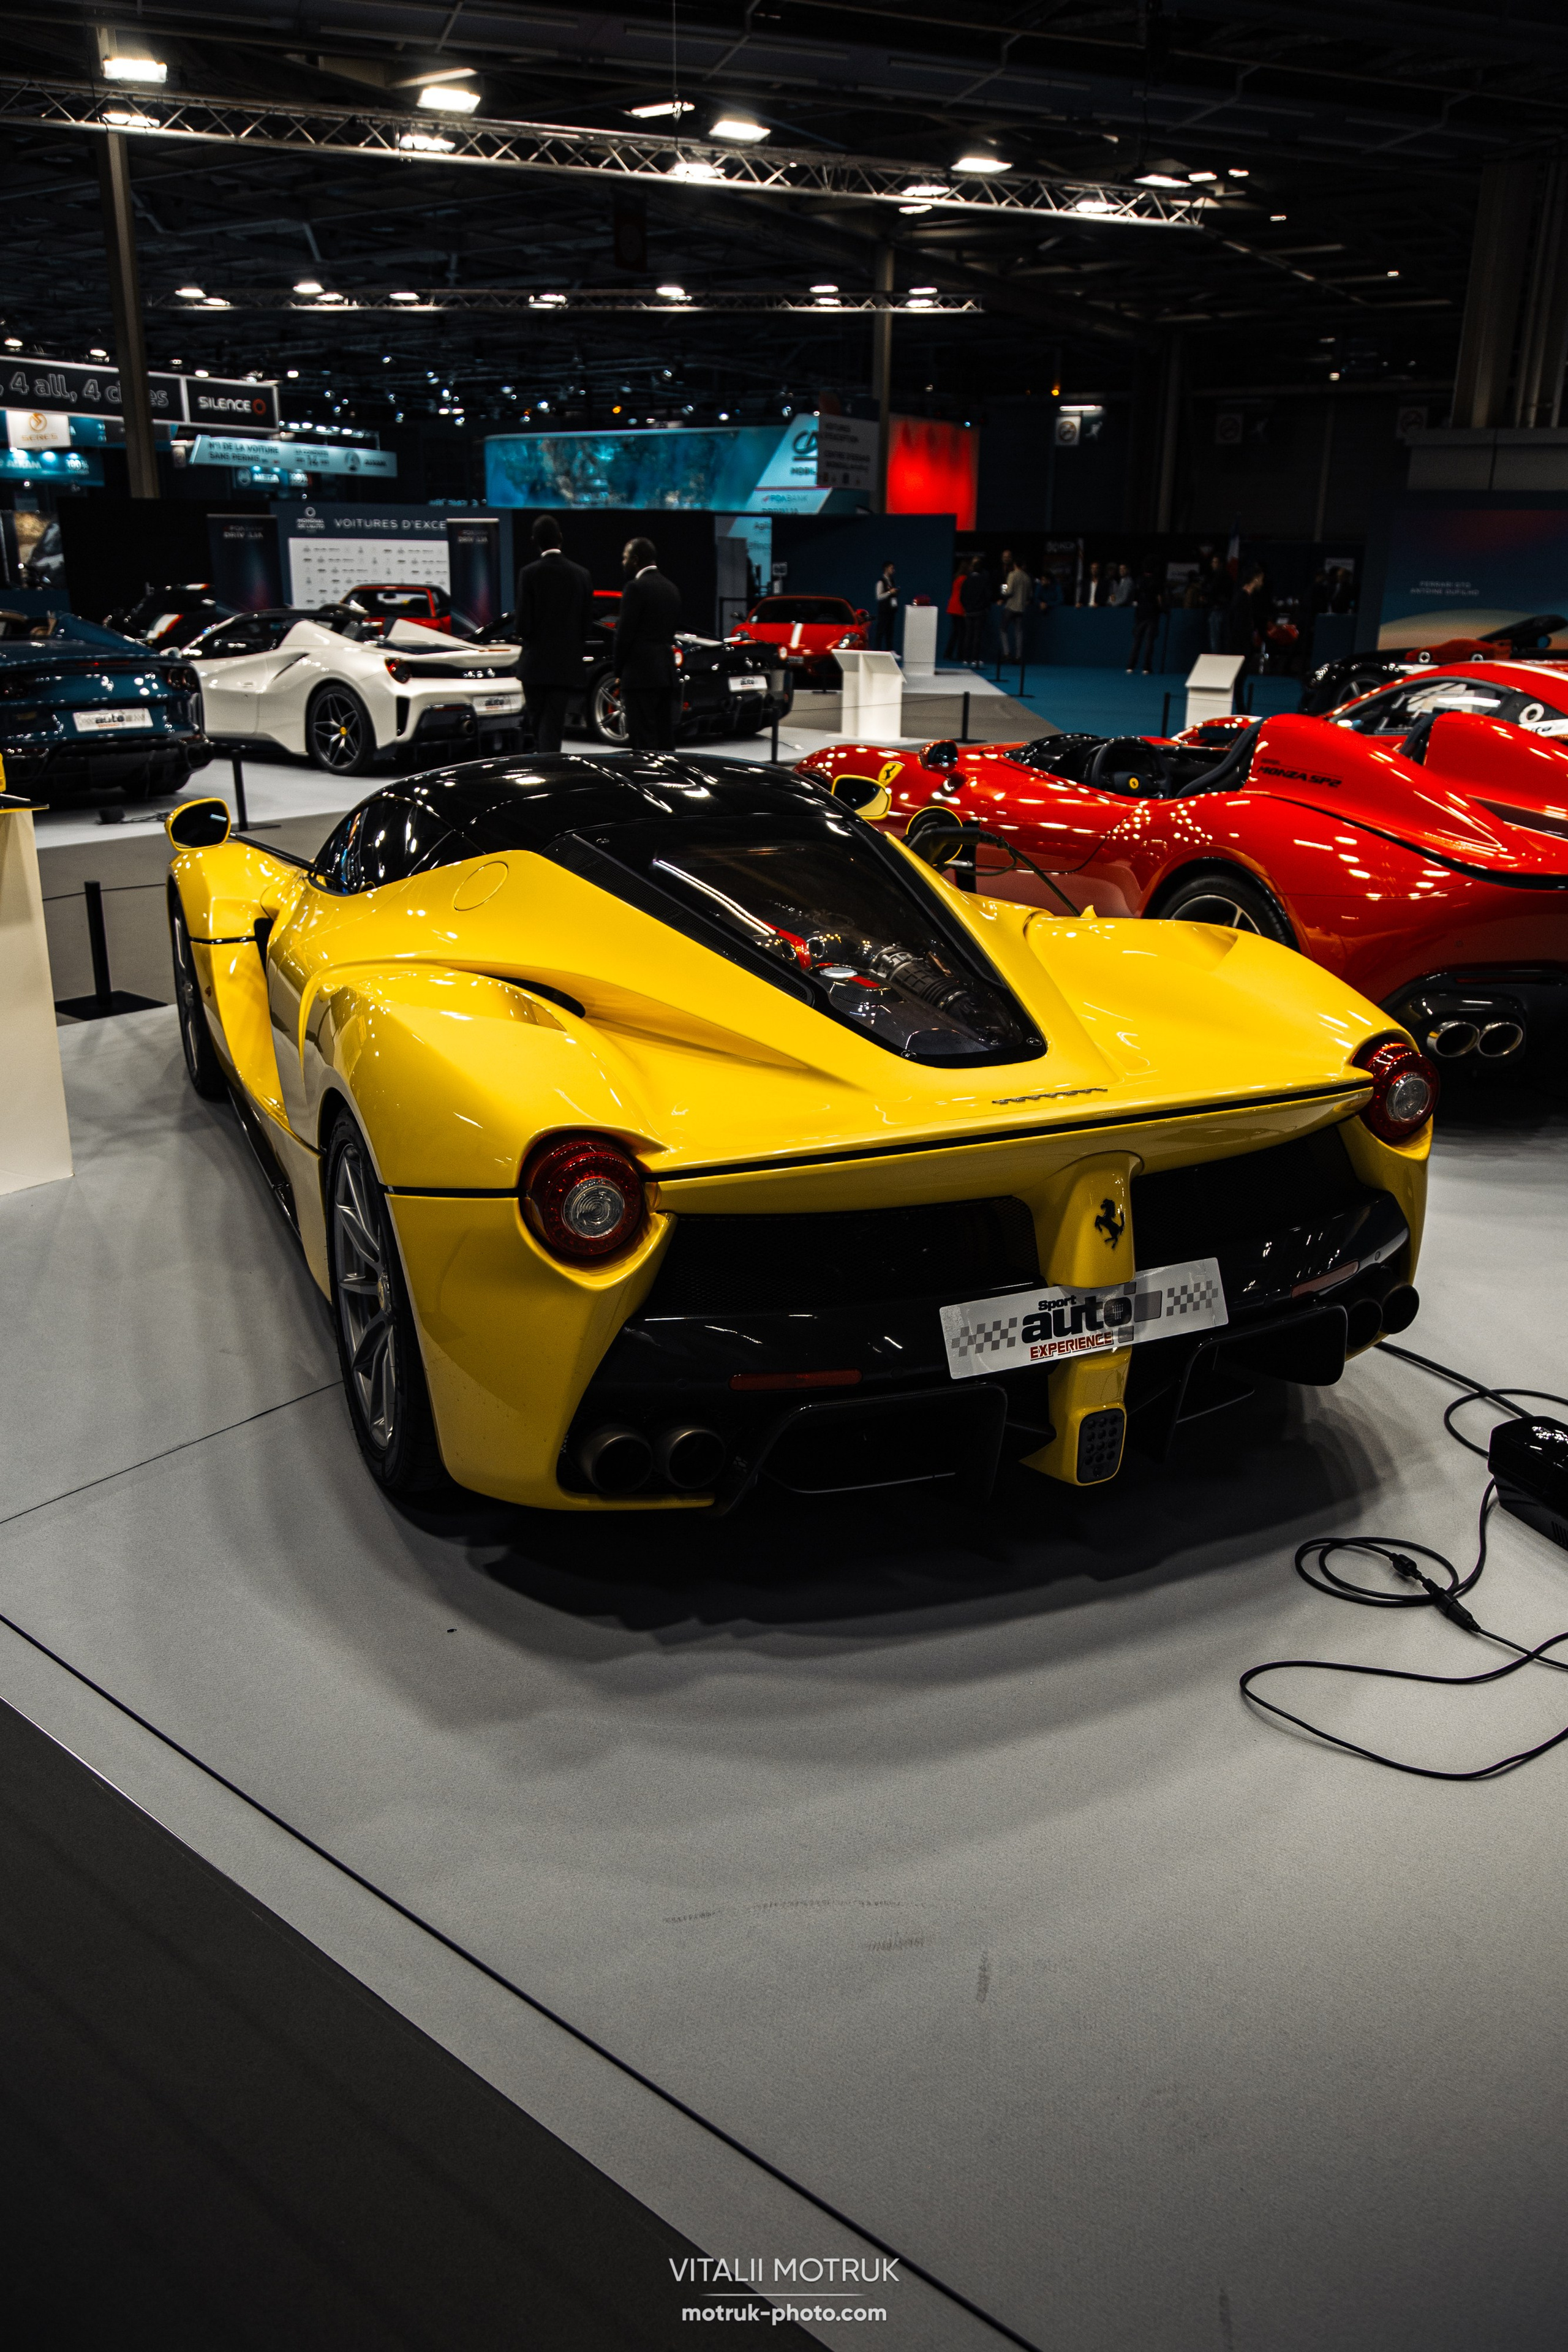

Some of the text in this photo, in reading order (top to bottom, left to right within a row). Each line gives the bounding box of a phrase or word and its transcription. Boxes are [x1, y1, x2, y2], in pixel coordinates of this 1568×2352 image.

[9, 371, 169, 409] 4 all, 4 cies
[197, 396, 252, 413] SILENCE
[21, 433, 59, 442] SERES
[209, 451, 261, 462] SANS PERMIS
[235, 443, 246, 451] LA
[247, 444, 280, 455] VOITURE
[334, 518, 398, 530] VOITURES
[1256, 766, 1343, 788] MONZA SP2
[1038, 1295, 1077, 1311] Sport
[1021, 1295, 1133, 1344] auto
[1030, 1331, 1114, 1360] EXPERIENCE
